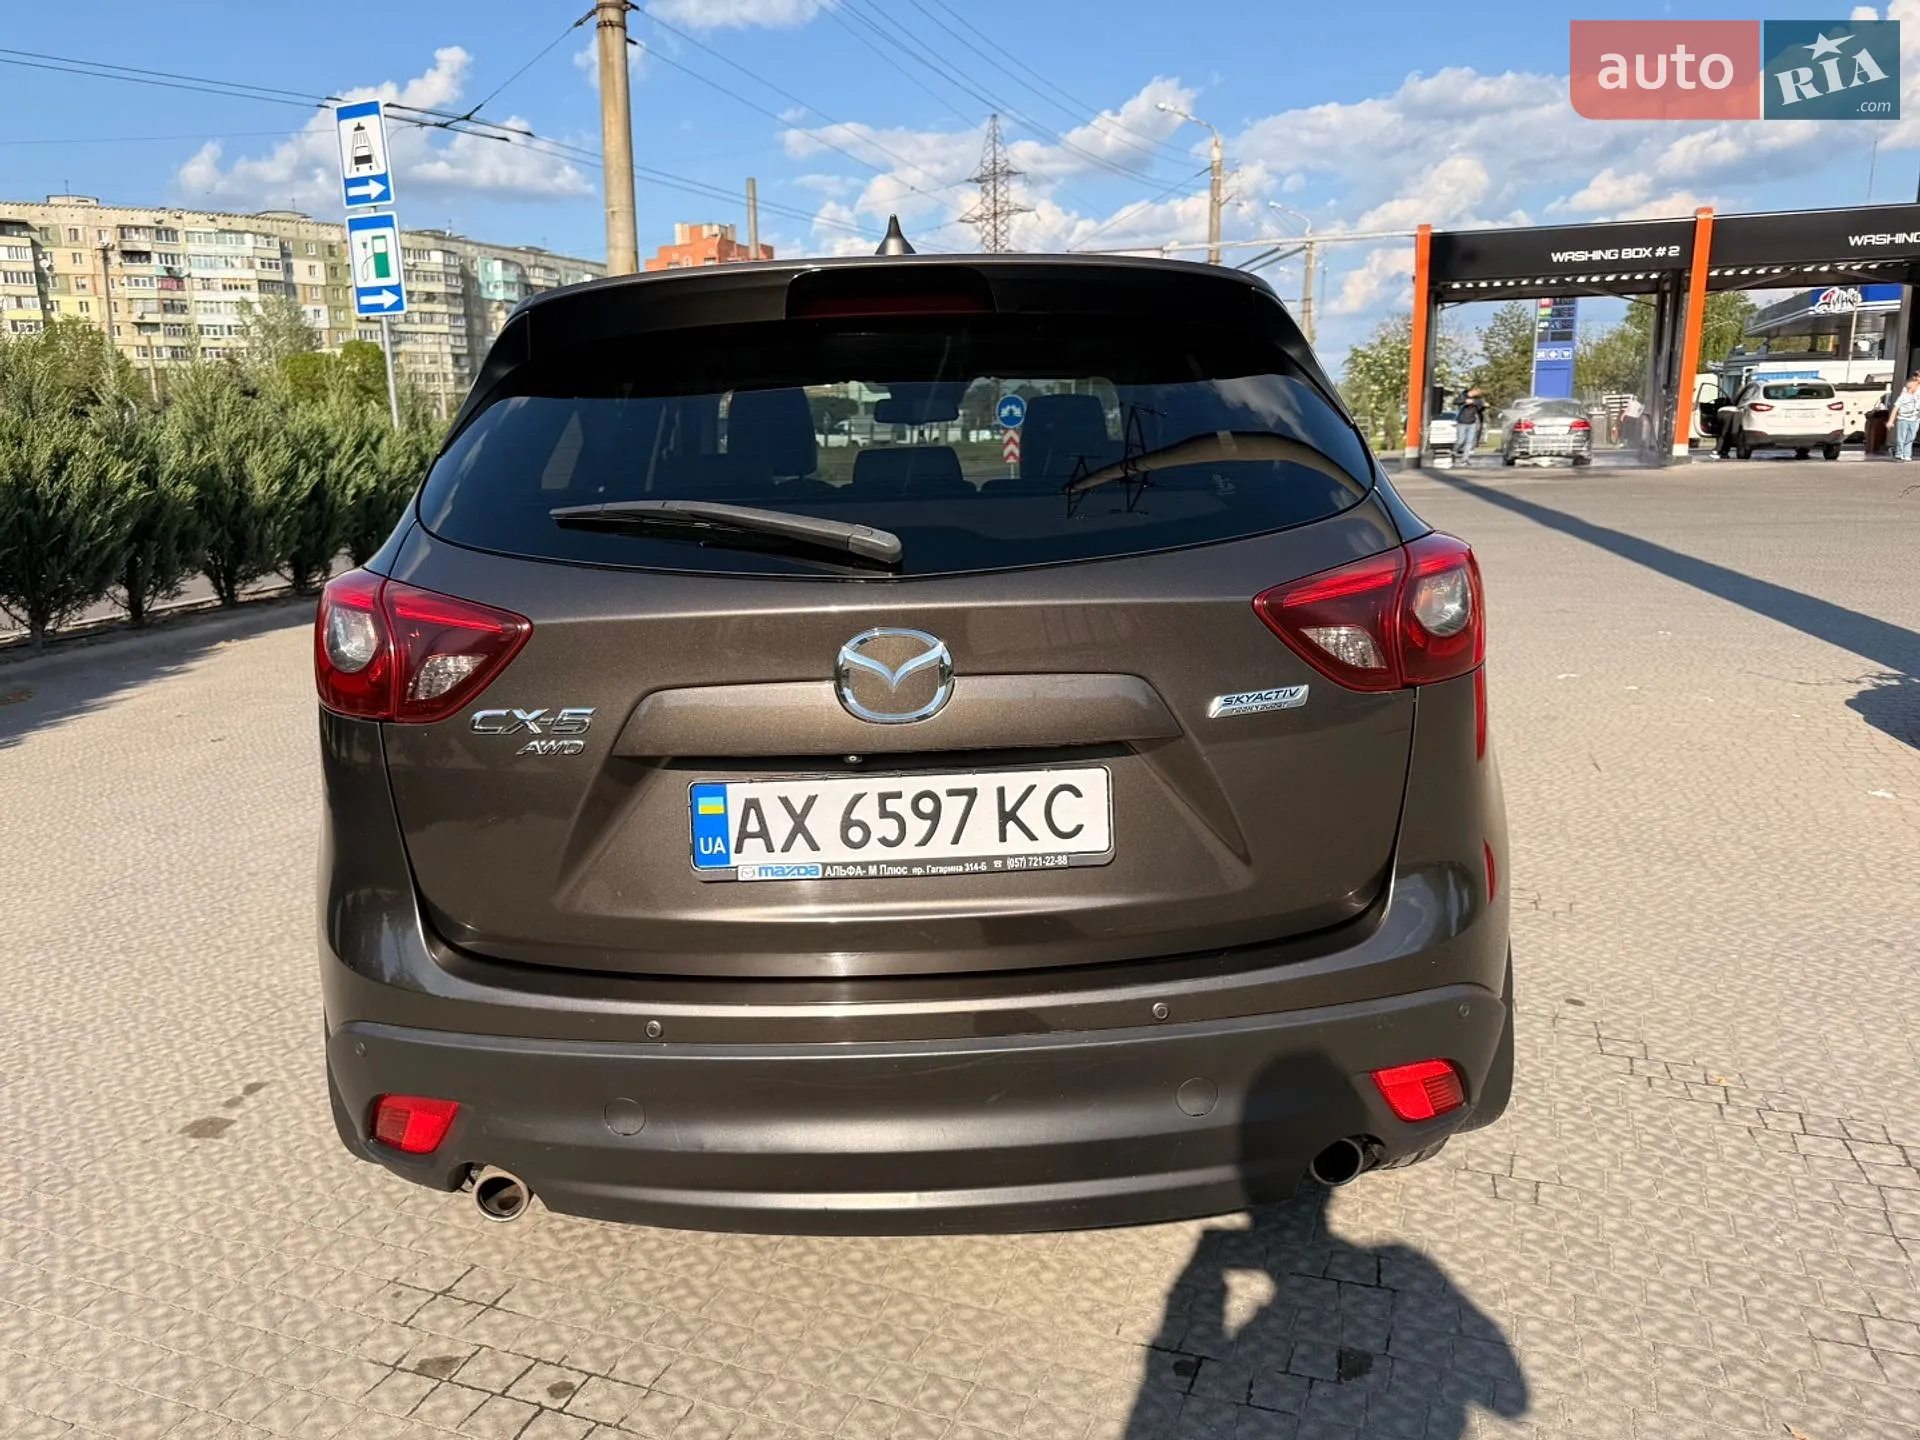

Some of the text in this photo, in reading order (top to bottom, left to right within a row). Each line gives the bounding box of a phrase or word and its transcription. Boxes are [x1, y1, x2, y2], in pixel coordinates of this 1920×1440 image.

[1551, 249, 1620, 262] WASHING
[1621, 247, 1653, 259] BOX
[1668, 245, 1681, 257] 2
[1222, 688, 1300, 706] SKYACTIV
[471, 708, 596, 734] CX-5
[515, 740, 586, 755] AWD
[734, 783, 1085, 854] AX 6597 KC
[700, 837, 726, 855] UA
